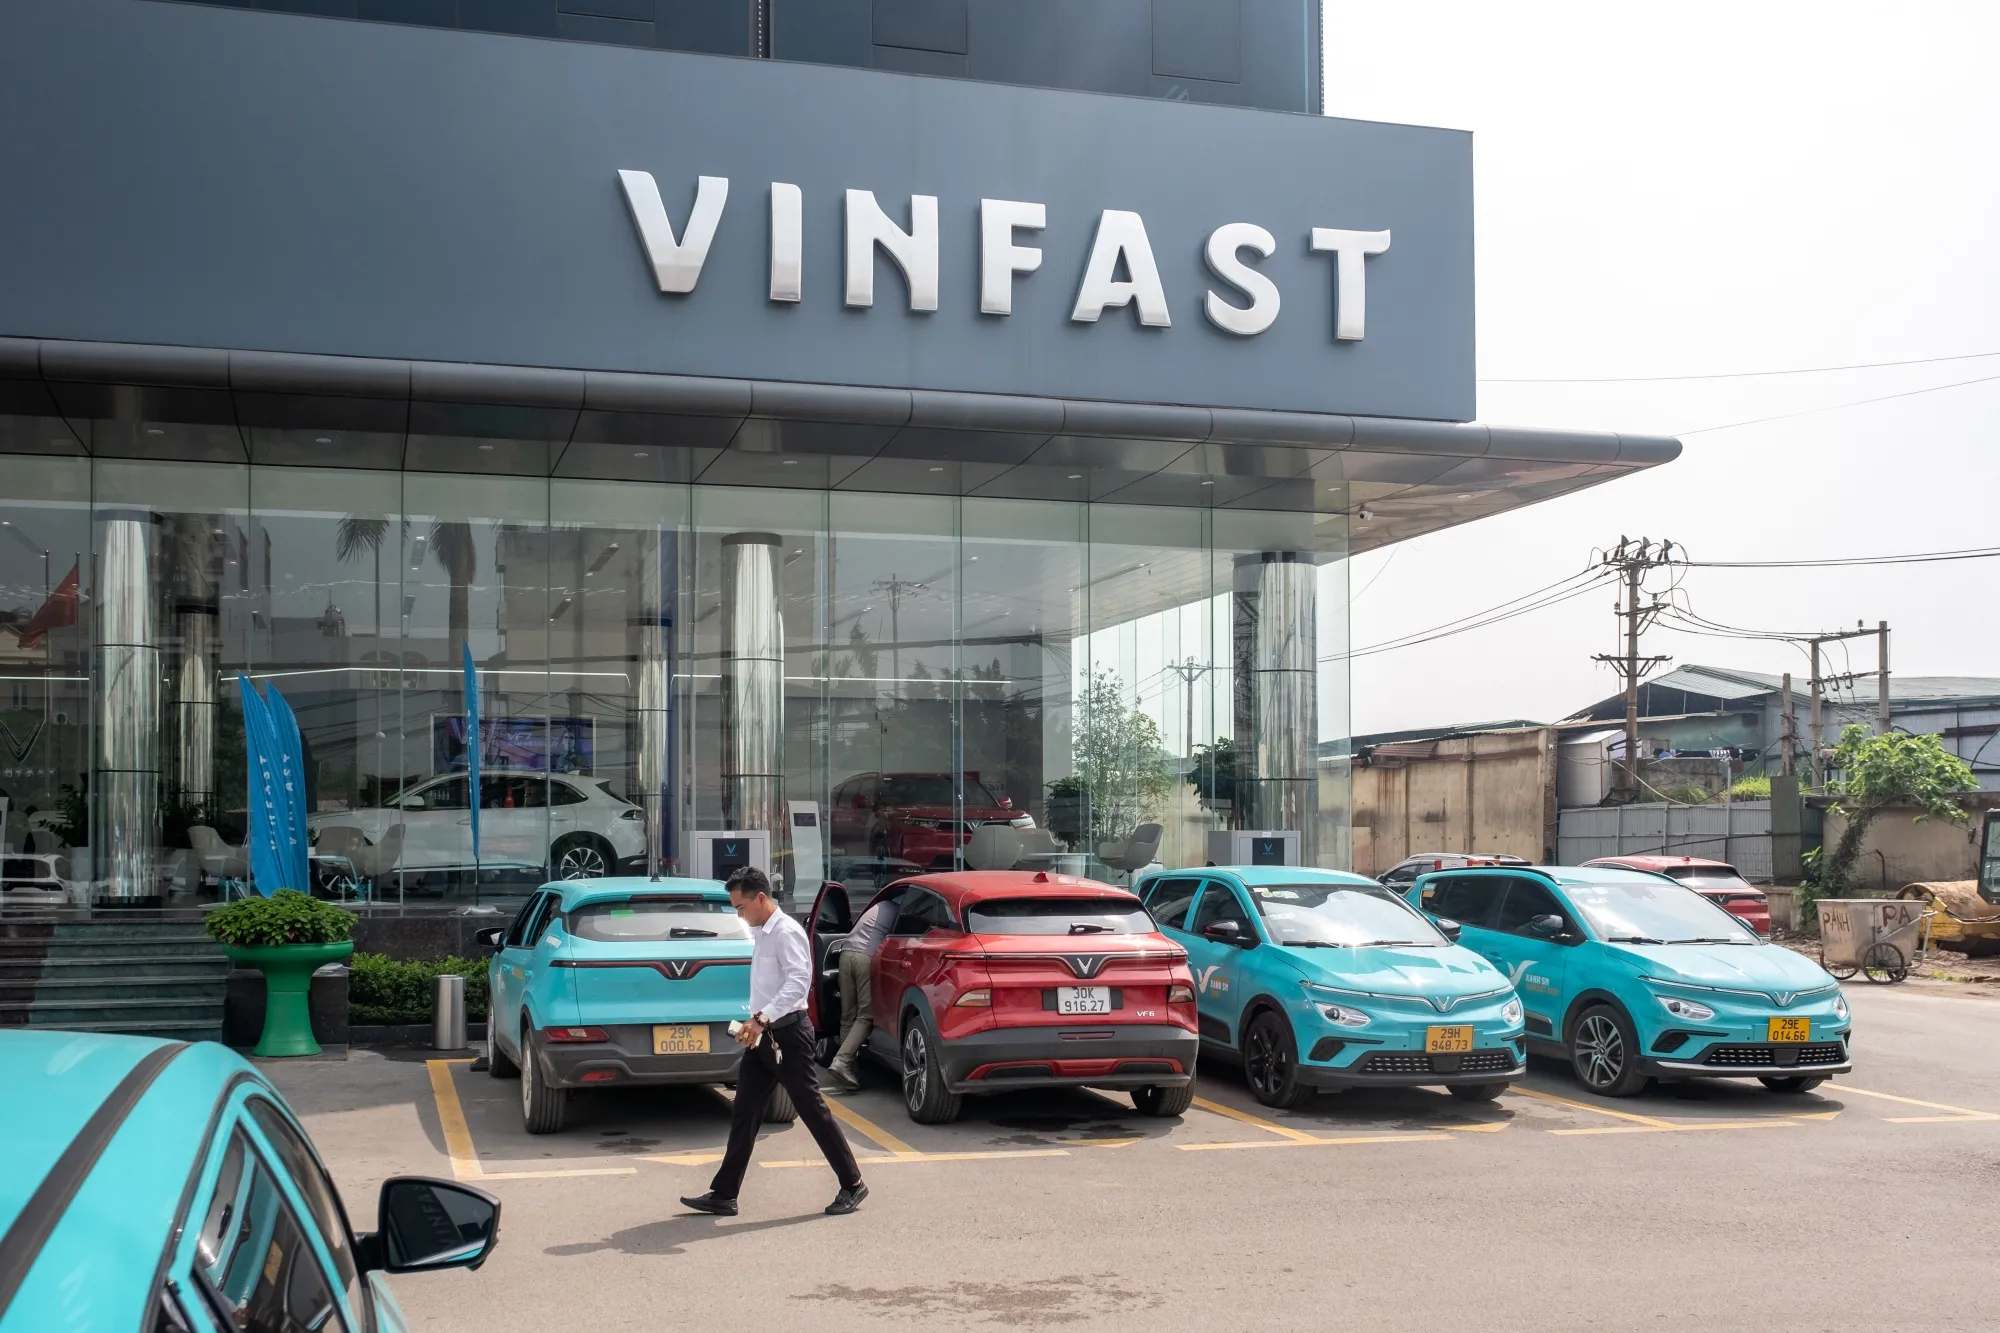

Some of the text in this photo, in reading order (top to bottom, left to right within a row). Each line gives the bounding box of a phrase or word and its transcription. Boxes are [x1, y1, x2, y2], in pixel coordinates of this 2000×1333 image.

[617, 169, 1391, 341] VINFAST
[1073, 987, 1095, 999] 30K
[1064, 1000, 1104, 1012] 916.27
[1781, 1019, 1800, 1030] 29E
[669, 1027, 693, 1039] 29K
[1440, 1028, 1461, 1039] 29H
[1772, 1030, 1806, 1041] 014.66
[660, 1039, 704, 1052] 000.62
[1431, 1039, 1468, 1051] 948.73
